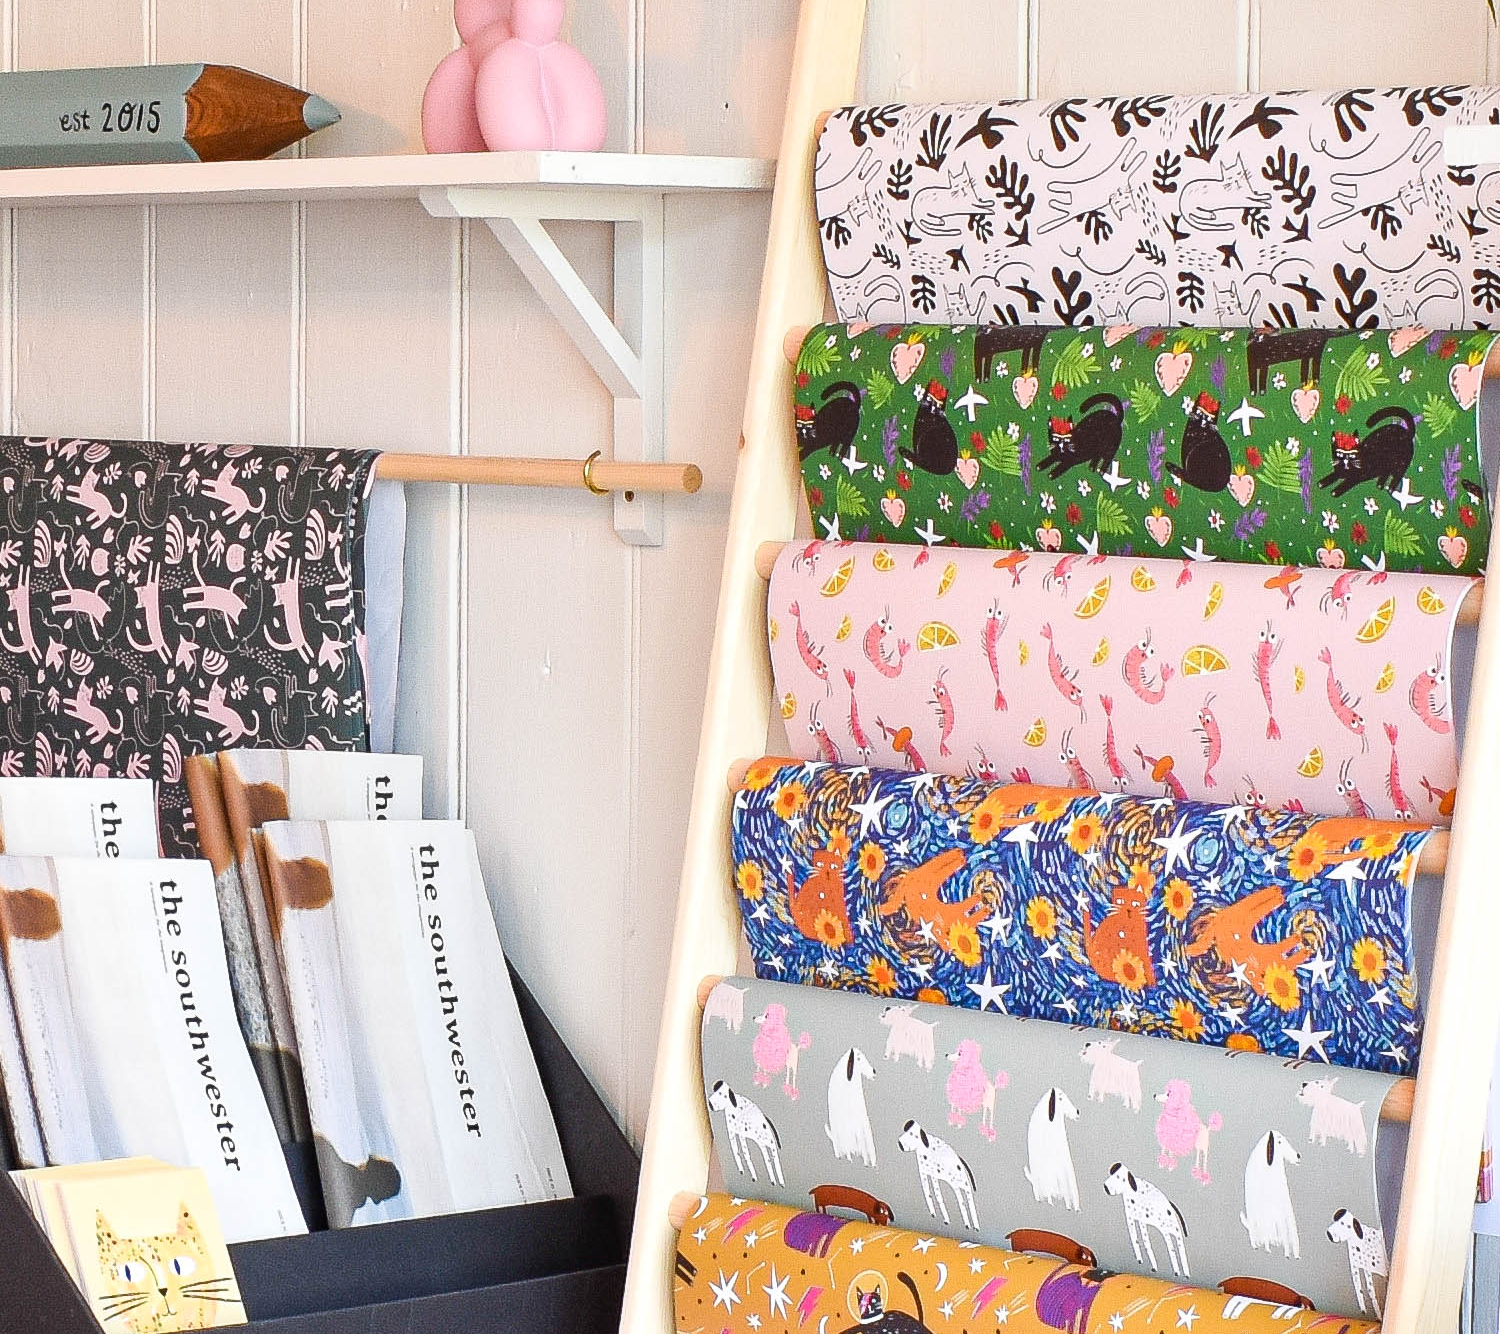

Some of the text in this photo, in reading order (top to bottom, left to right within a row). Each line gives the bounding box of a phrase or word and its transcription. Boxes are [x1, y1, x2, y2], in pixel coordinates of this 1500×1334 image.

[59, 109, 91, 132] est
[101, 100, 162, 134] 2015
[100, 799, 123, 858] the
[160, 879, 241, 1171] the southwester
[418, 842, 483, 1139] the southwester
